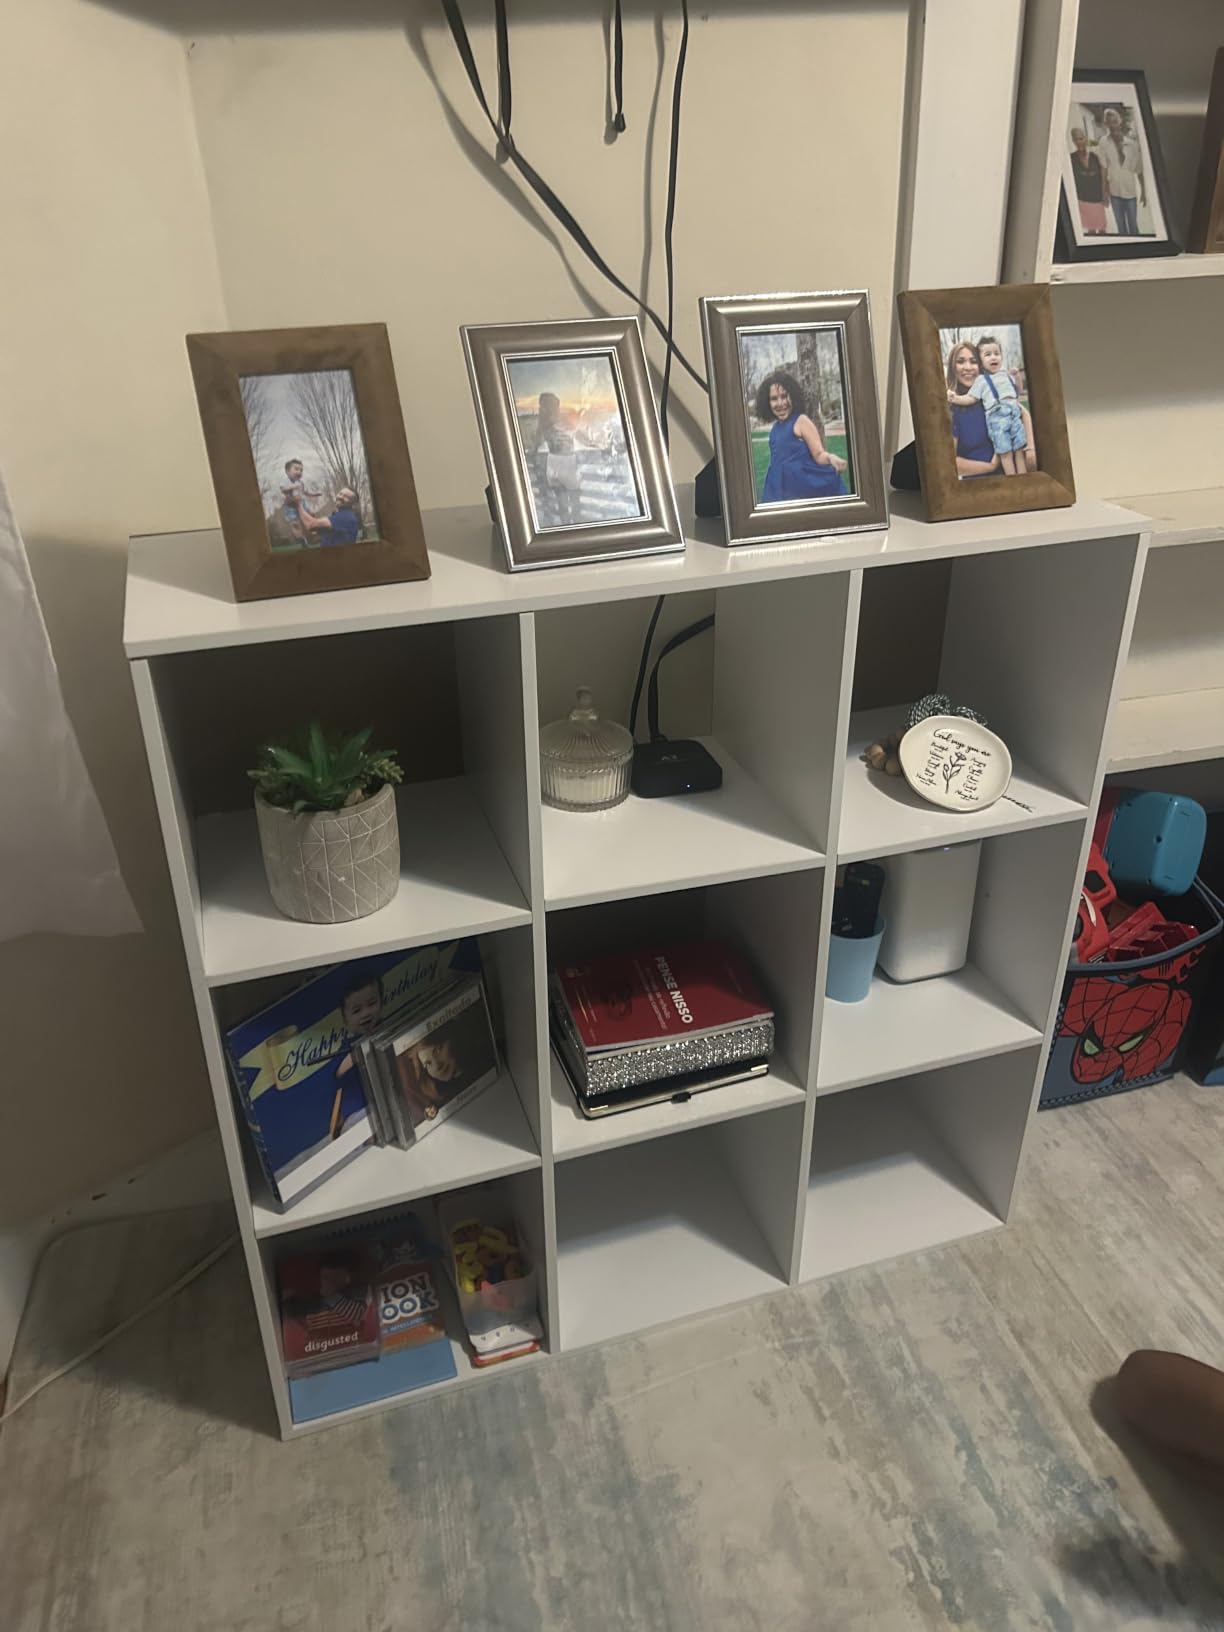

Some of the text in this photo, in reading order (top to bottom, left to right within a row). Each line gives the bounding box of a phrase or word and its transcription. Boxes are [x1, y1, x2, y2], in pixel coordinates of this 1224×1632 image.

[933, 728, 952, 742] God
[654, 956, 694, 1024] PENSE NISSO
[278, 958, 439, 1081] Happy irthday
[381, 1275, 427, 1303] ION
[382, 1291, 435, 1320] OOK
[304, 1331, 359, 1352] disgusted
